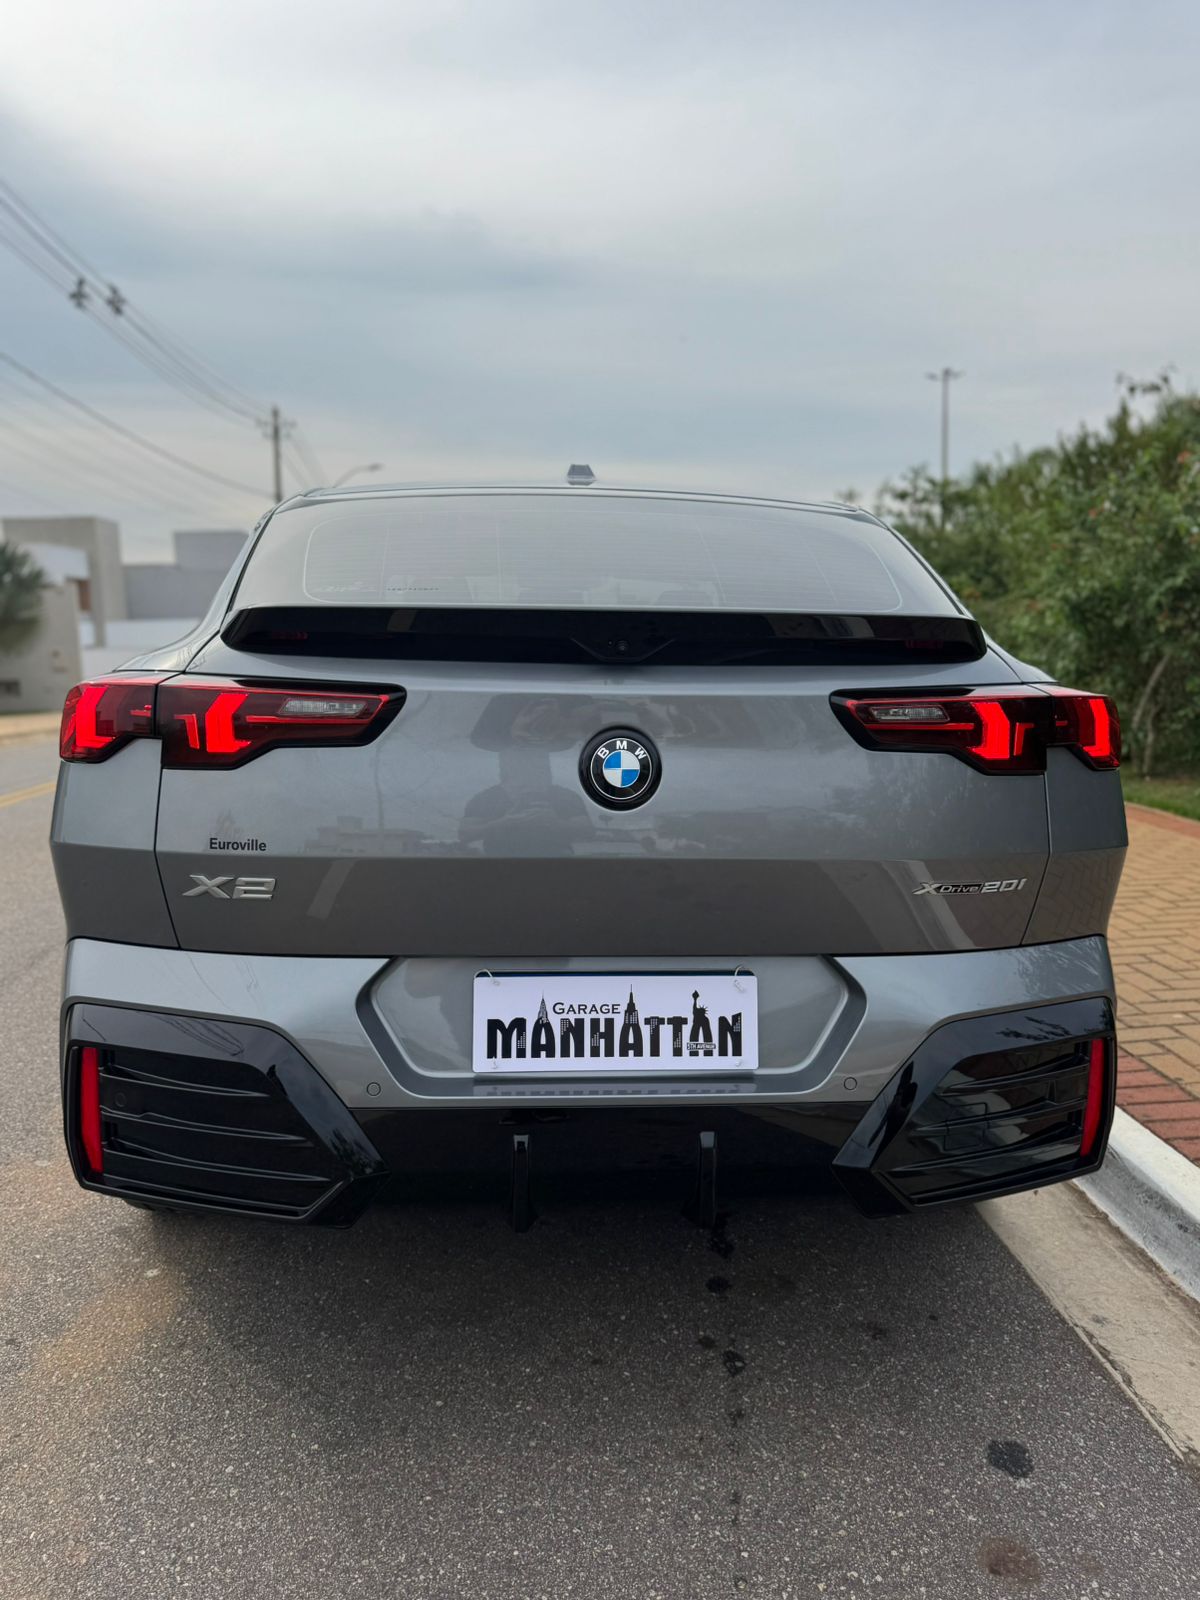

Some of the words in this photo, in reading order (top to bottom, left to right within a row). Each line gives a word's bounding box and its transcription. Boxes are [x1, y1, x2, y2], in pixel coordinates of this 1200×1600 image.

[597, 740, 646, 760] BMW
[209, 838, 267, 852] Euroville
[182, 874, 276, 900] X2
[486, 1008, 743, 1059] MANHATTAN
